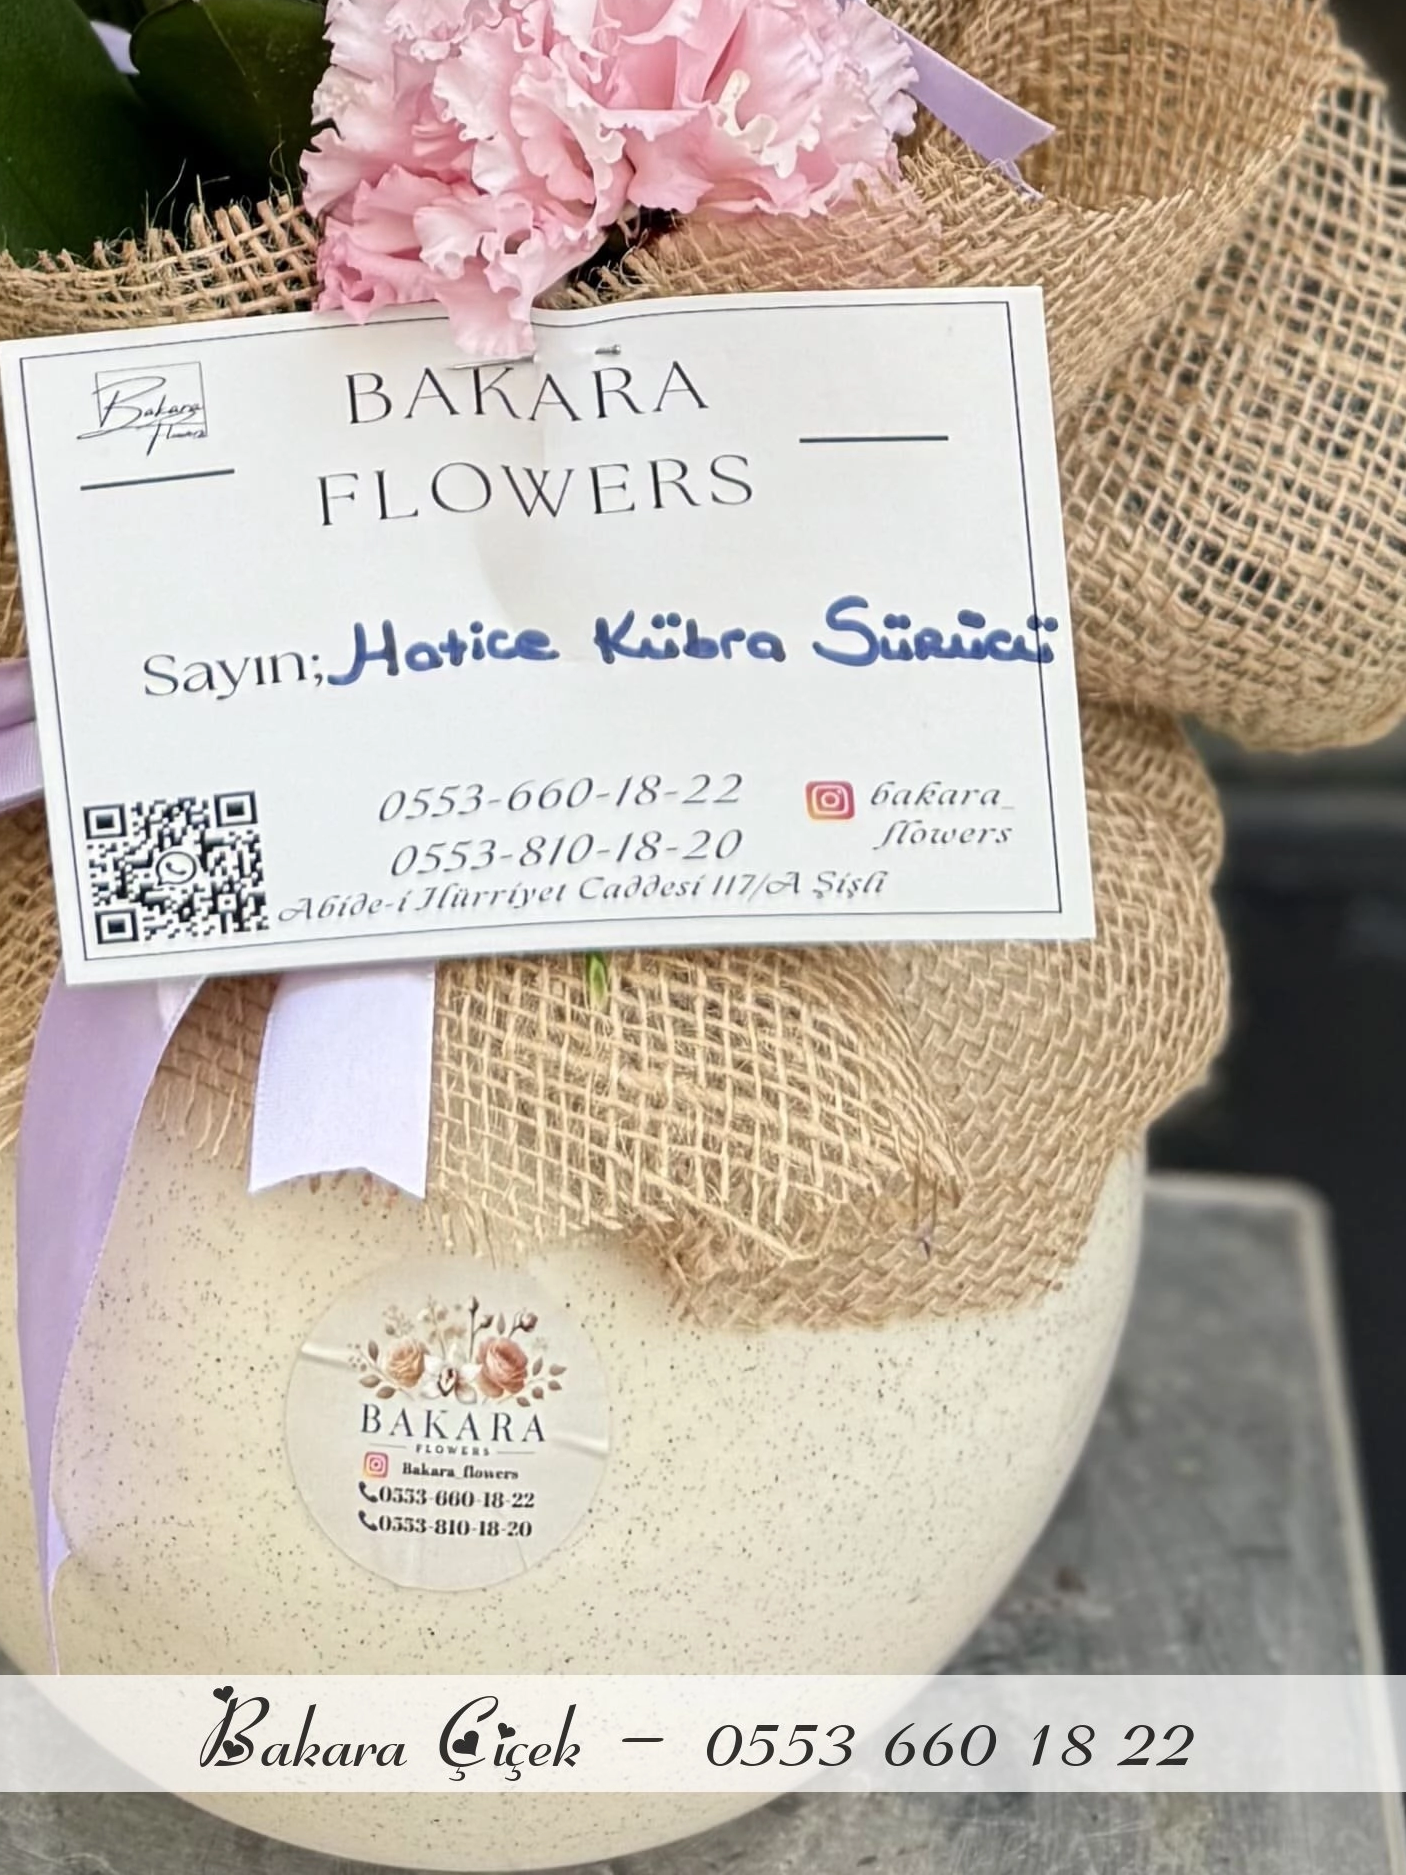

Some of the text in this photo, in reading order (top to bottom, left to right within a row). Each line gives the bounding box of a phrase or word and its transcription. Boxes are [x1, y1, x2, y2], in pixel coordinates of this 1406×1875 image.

[345, 360, 709, 426] BAKARA
[318, 454, 755, 527] FLOWERS
[594, 610, 786, 664] Kübra
[143, 651, 324, 700] Sayın;
[378, 773, 743, 822] 0553-660-18-22
[391, 829, 742, 876] 0553-810-18-20
[875, 820, 1012, 851] flowers
[278, 891, 409, 922] Abide-i
[578, 874, 705, 901] Caddesi
[711, 872, 800, 903] 117/A
[812, 870, 888, 900] Şişli
[361, 1403, 546, 1443] BAKARA
[402, 1462, 519, 1480] Bakara_flowers
[416, 1444, 490, 1457] FLOWERS
[378, 1486, 535, 1509] 0553-660-18-22
[378, 1515, 532, 1538] 0553-810-18-20
